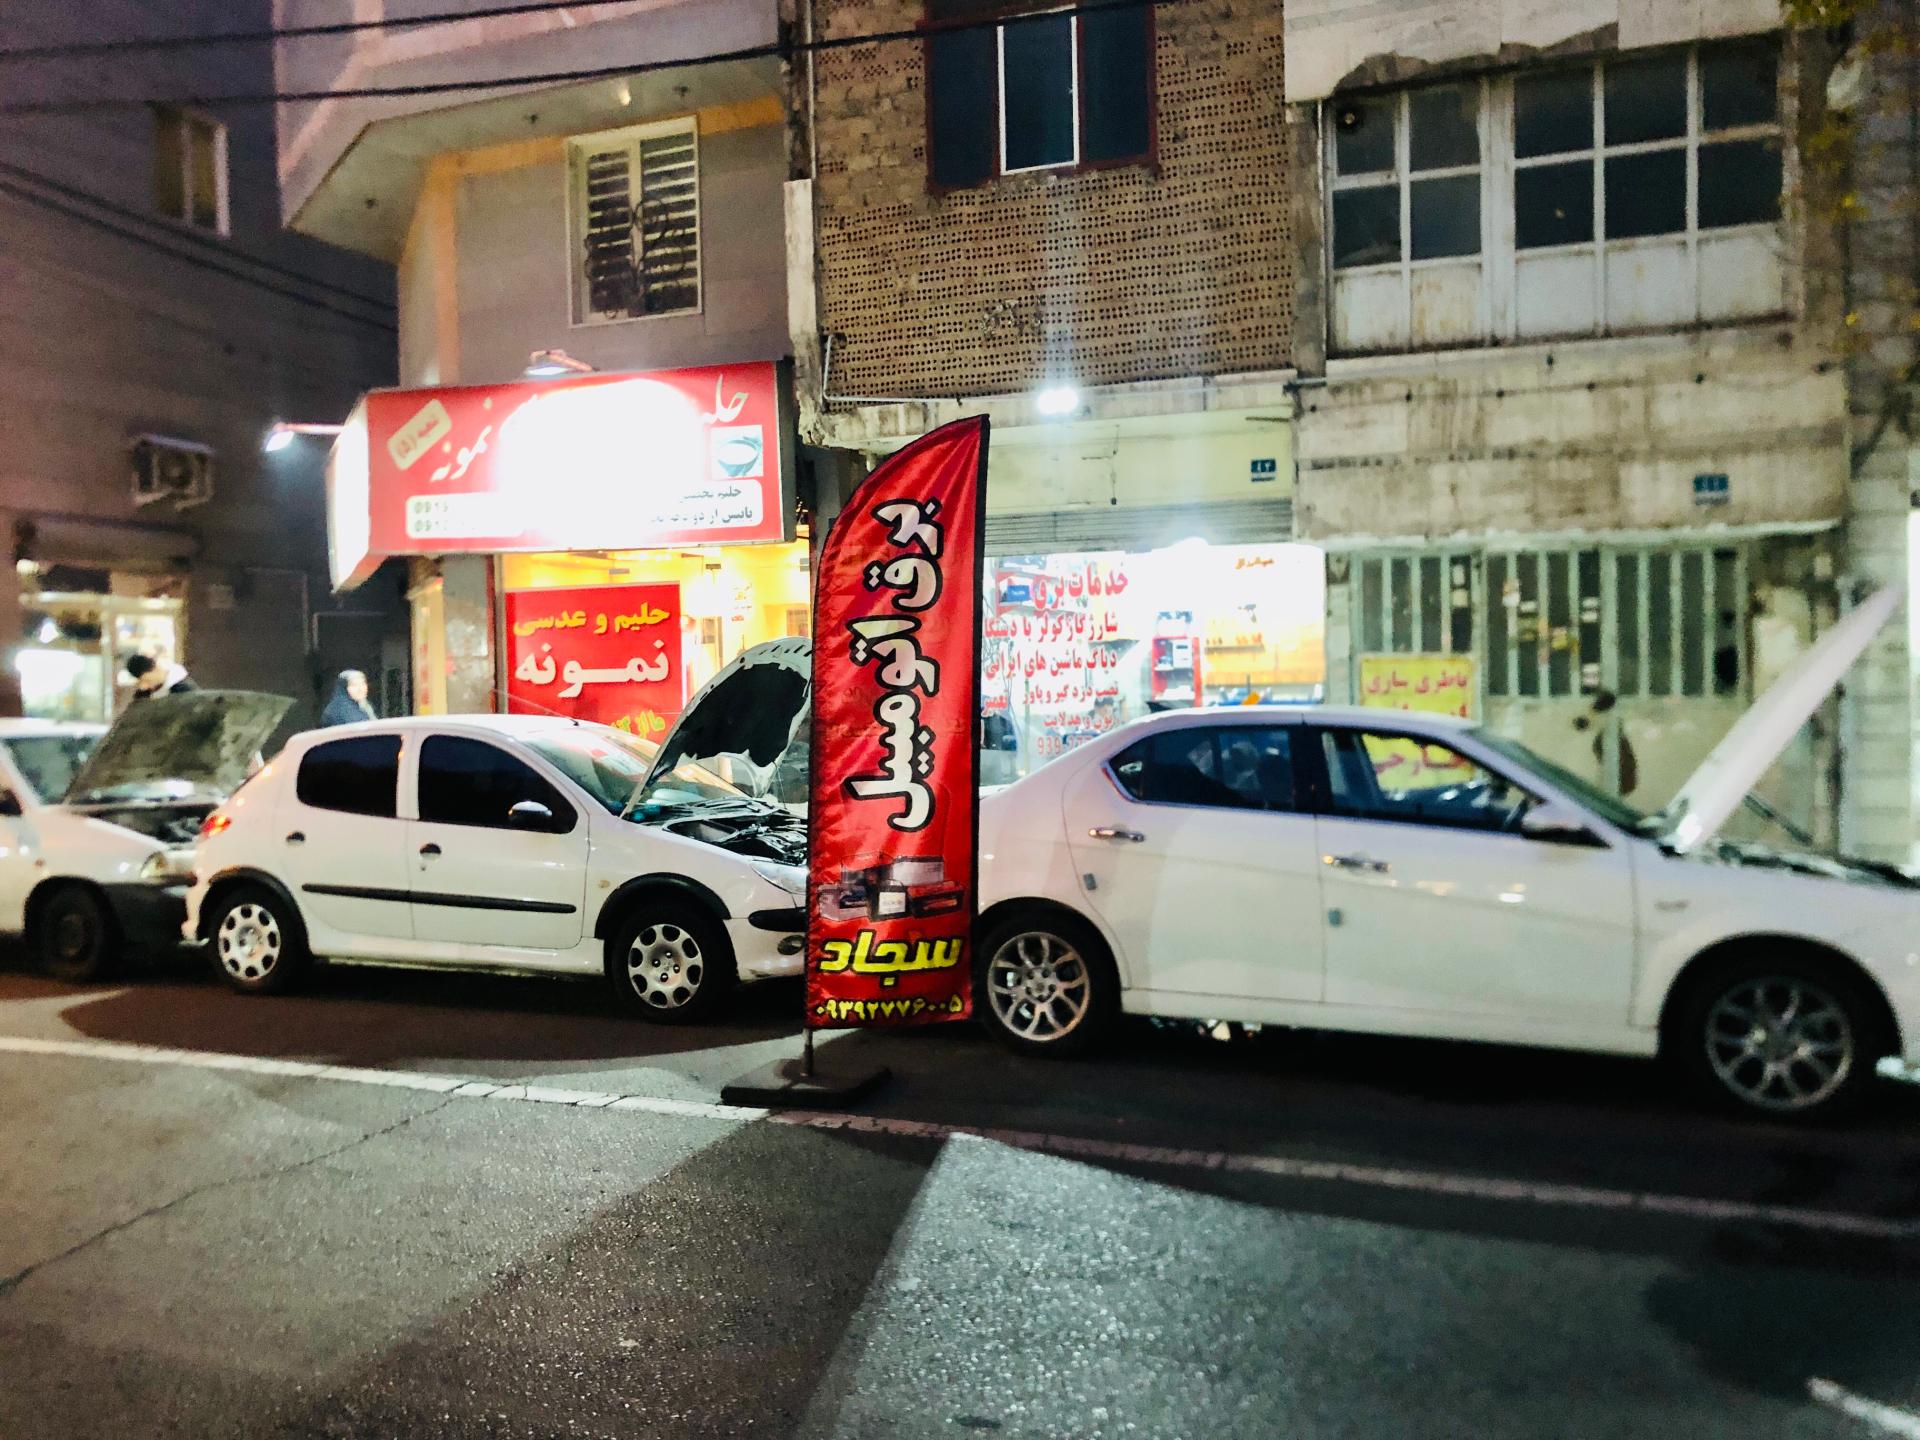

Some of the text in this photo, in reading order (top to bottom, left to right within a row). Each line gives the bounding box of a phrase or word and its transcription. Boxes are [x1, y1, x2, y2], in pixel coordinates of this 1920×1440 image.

[1068, 562, 1129, 597] خدمات
[513, 602, 671, 636] حلیم و عدسی
[1023, 616, 1032, 641] با
[514, 639, 669, 698] نمونه
[850, 500, 939, 830] برق اتومبیل
[1024, 650, 1046, 678] های
[819, 930, 964, 987] سجاد
